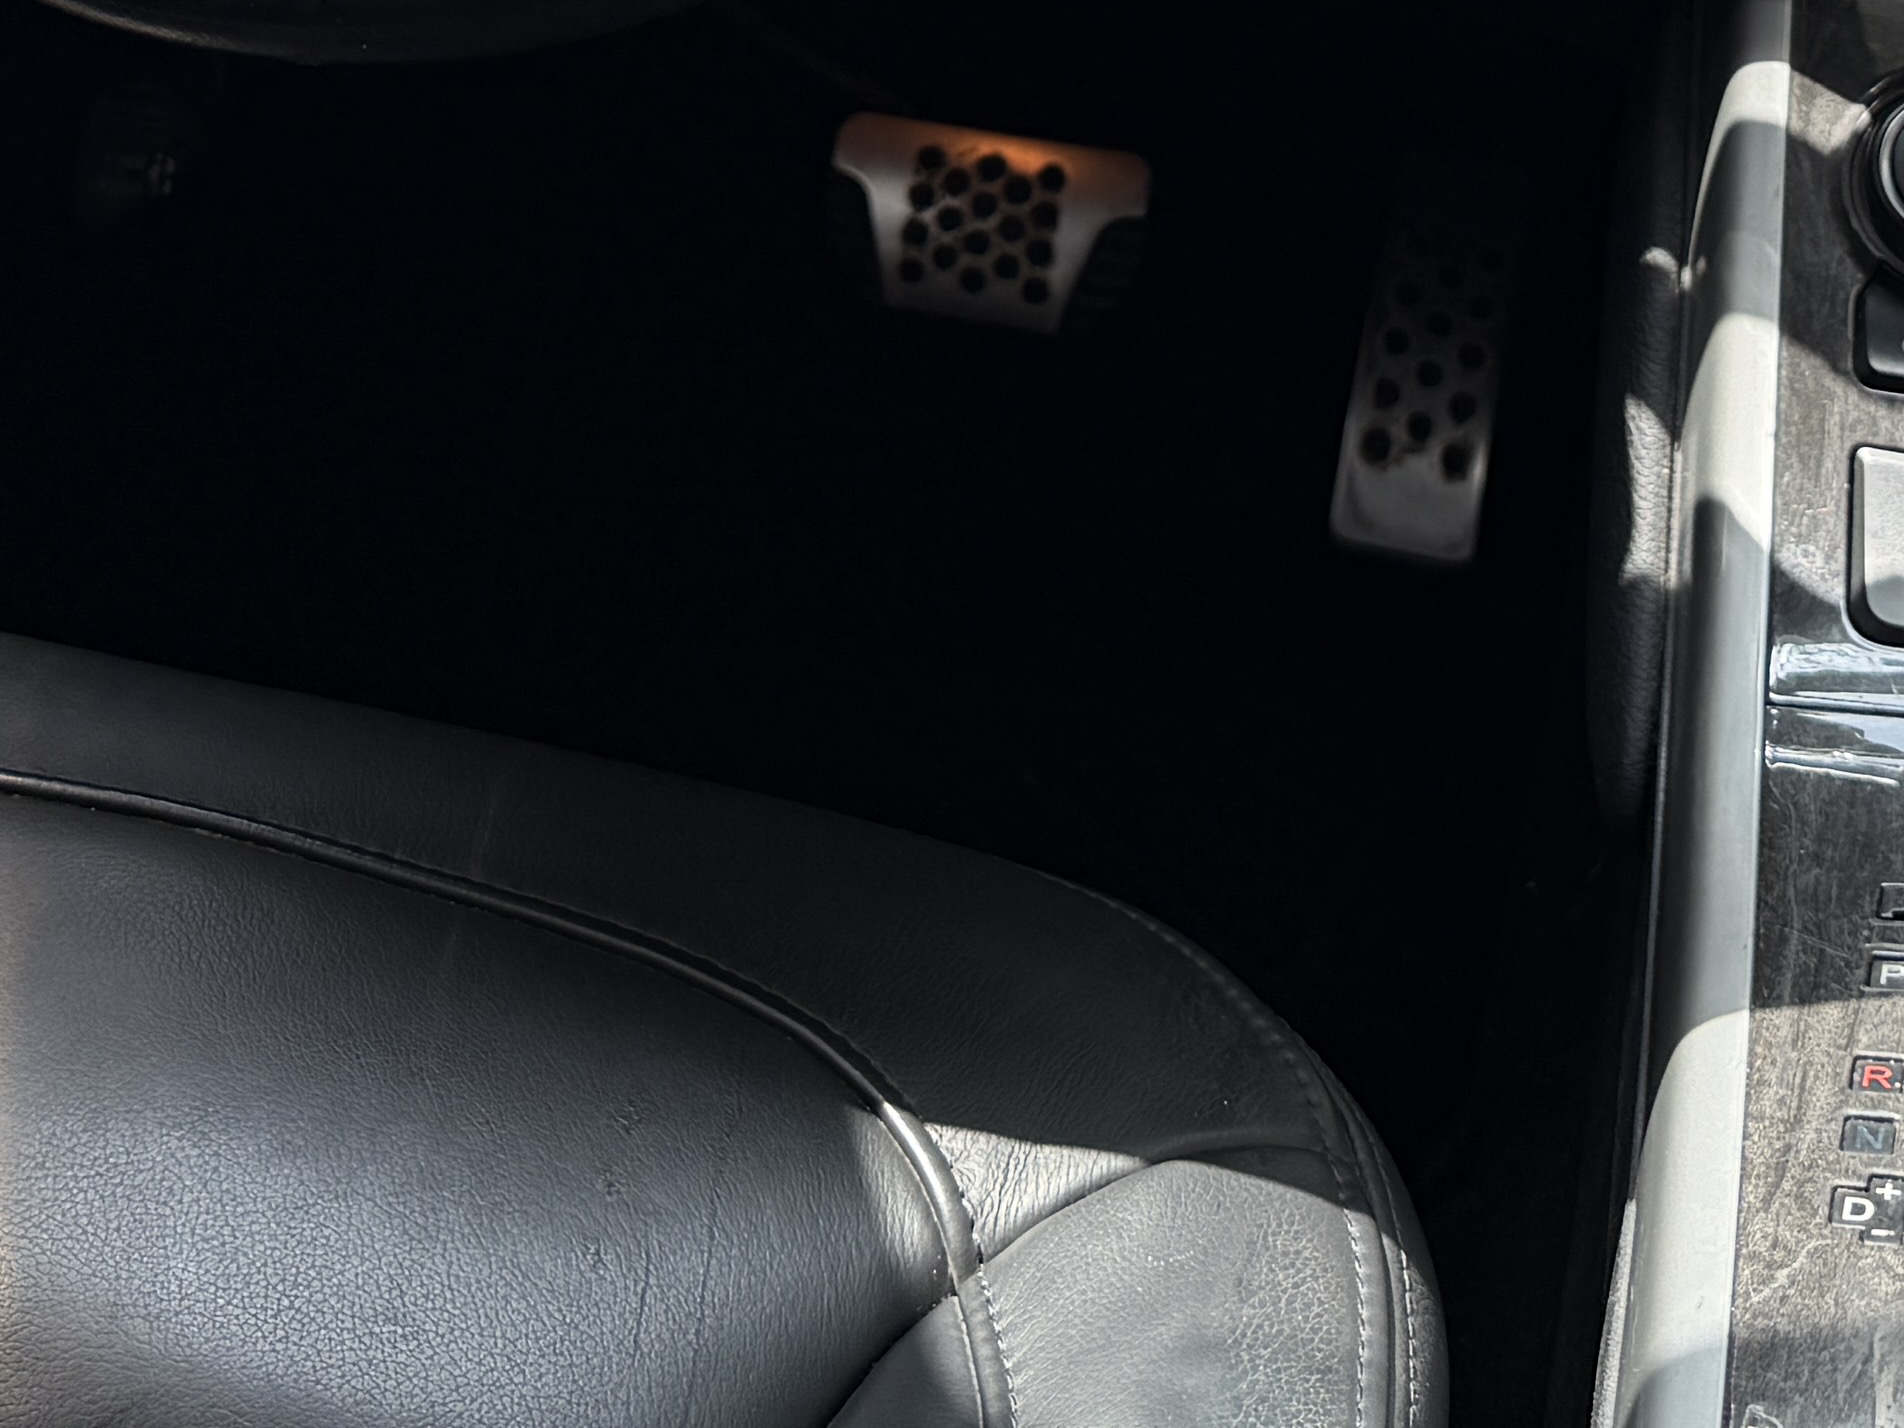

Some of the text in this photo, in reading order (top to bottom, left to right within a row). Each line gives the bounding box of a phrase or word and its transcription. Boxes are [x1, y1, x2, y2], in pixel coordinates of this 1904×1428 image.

[1862, 1065, 1893, 1089] R
[1856, 1125, 1885, 1150] N
[1842, 1196, 1875, 1221] D
